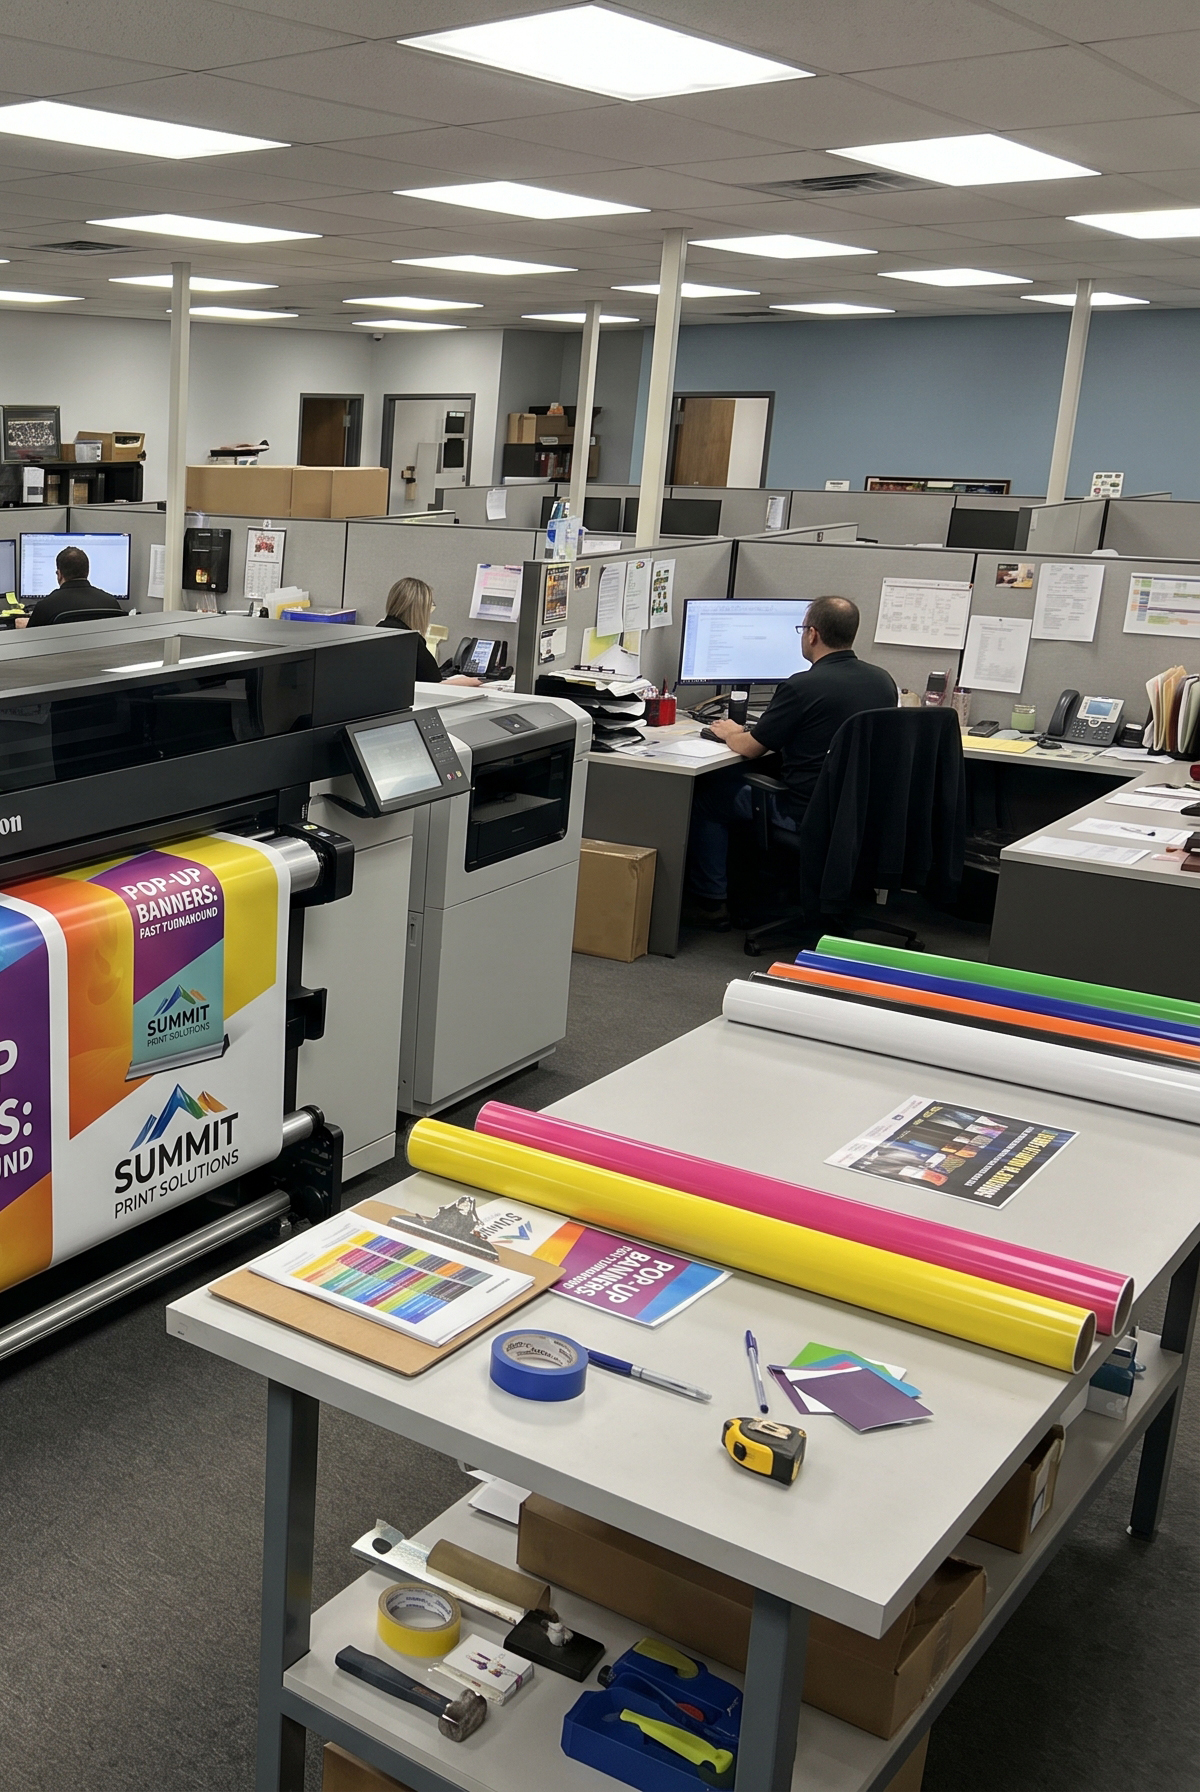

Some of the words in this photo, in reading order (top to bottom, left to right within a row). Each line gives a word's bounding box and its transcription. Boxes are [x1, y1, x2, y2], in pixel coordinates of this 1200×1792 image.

[120, 867, 201, 901] POP-UP
[135, 884, 218, 924] BANNERS:
[147, 1003, 210, 1037] SUMMIT
[169, 1022, 210, 1041] SOLUTIONS
[114, 1112, 239, 1194] SUMMIT
[114, 1185, 157, 1219] PRINT
[159, 1149, 239, 1197] SOLUTIONS
[605, 1259, 675, 1304] POP-UP
